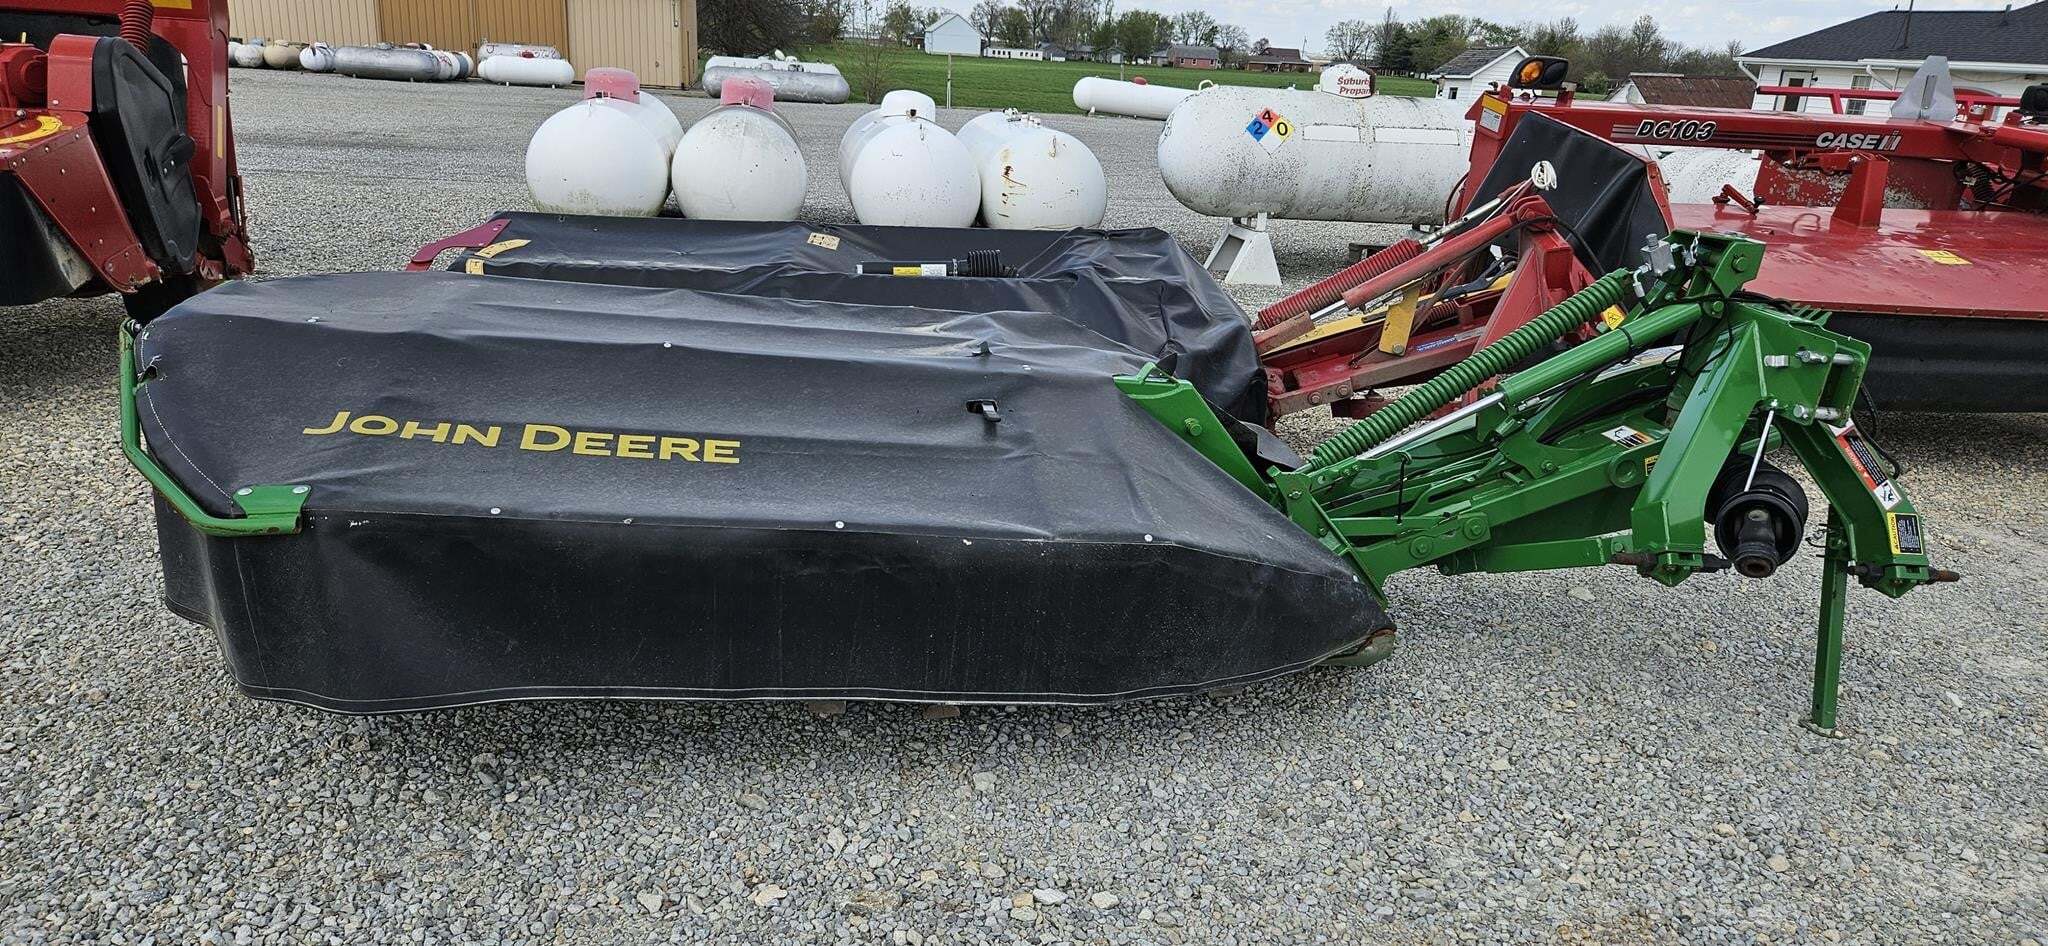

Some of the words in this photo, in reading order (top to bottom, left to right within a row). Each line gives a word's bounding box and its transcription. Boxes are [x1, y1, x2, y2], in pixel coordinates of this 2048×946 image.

[1262, 110, 1273, 122] 4
[1254, 121, 1263, 135] 2
[1276, 122, 1288, 136] 0
[1635, 119, 1717, 141] DC103
[302, 411, 502, 447] JOHN
[520, 424, 741, 464] DEERE
